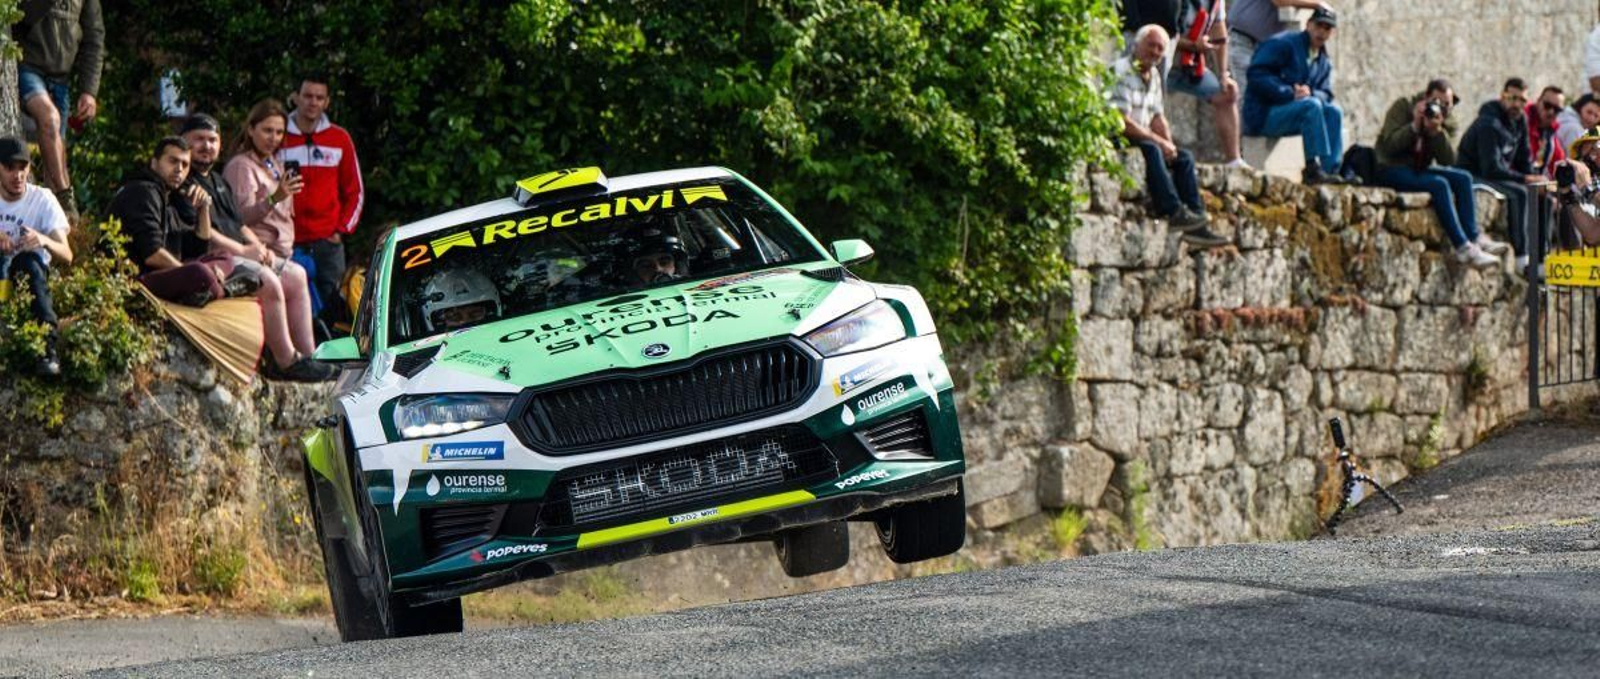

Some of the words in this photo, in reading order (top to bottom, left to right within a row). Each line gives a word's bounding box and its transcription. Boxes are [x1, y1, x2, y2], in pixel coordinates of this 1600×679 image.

[482, 189, 674, 244] Recalvi
[401, 244, 432, 269] 2
[1546, 263, 1573, 280] ICO
[499, 285, 765, 343] ourense
[857, 382, 905, 411] ourense
[444, 447, 497, 457] MICHELIN
[444, 475, 506, 487] ourense
[450, 486, 482, 495] provincia
